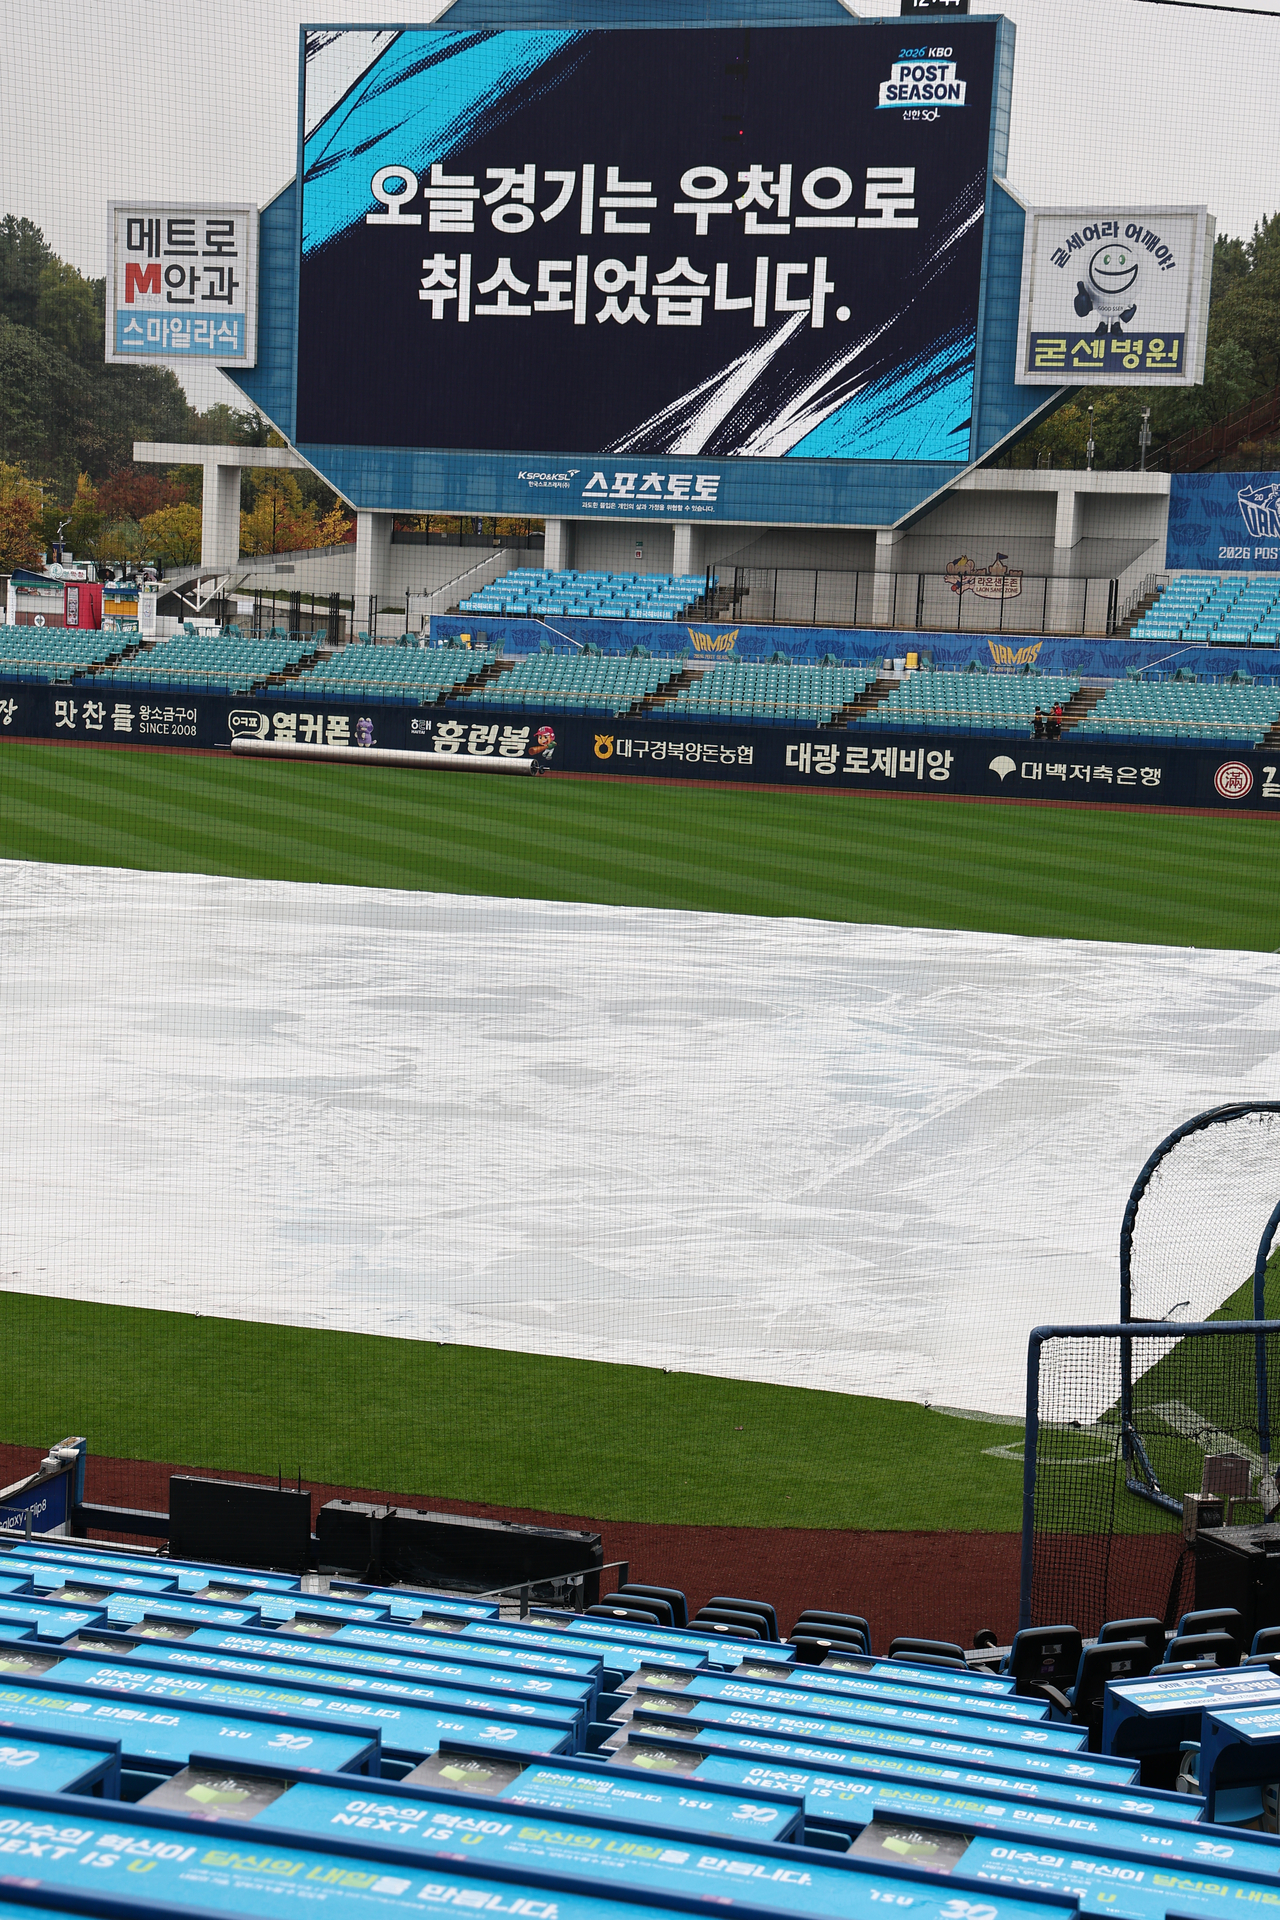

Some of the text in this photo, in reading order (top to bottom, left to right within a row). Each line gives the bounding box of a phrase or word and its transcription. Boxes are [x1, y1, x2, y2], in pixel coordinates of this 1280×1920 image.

[898, 46, 953, 58] 2026 KBO
[900, 65, 949, 82] POST
[886, 83, 960, 101] SEASON
[902, 109, 920, 120] 신한
[366, 164, 920, 236] 오늘경기는 우천으로
[127, 218, 238, 258] 메트로
[1050, 221, 1176, 271] 굳세어라 어깨야!
[418, 253, 852, 329] 취소되었습니다.
[122, 317, 238, 350] 스마일라식
[1035, 338, 1179, 369] 굳센병원
[518, 471, 571, 480] KSPO&KSL
[528, 481, 570, 489] 한국스포츠레저(주)
[582, 471, 721, 501] 스포츠토토
[599, 502, 616, 510] 몰입은
[636, 503, 647, 511] 삶과
[692, 505, 715, 513] 있습니다.
[1218, 547, 1280, 560] 2026 POS
[687, 627, 739, 652] VAMOS
[988, 639, 1043, 665] VAMOS
[55, 700, 136, 733] 맛찬들
[139, 705, 197, 724] 왕소금구이
[139, 722, 197, 736] SINCE 2008
[273, 711, 350, 746] 옆커폰
[410, 718, 432, 731] 해태
[432, 720, 530, 757] 홈런볼
[616, 739, 754, 766] 대구경북양돈농협
[785, 743, 954, 782] 대광 로제비앙
[1021, 762, 1162, 786] 대백저축은행
[1225, 771, 1243, 789] 滿
[246, 1579, 268, 1587] 30
[85, 1676, 144, 1691] NEXT
[145, 1685, 166, 1695] IS
[522, 1680, 553, 1691] 30
[267, 1733, 314, 1750] 30
[479, 1725, 518, 1742] 30
[742, 1776, 855, 1801] NEXT IS U
[731, 1803, 778, 1822] 30
[1119, 1800, 1154, 1814] 30
[330, 1813, 485, 1845] NEXT IS U
[1192, 1840, 1234, 1859] 30
[79, 1850, 121, 1868] IS
[127, 1858, 159, 1873] U
[1097, 1892, 1117, 1903] U
